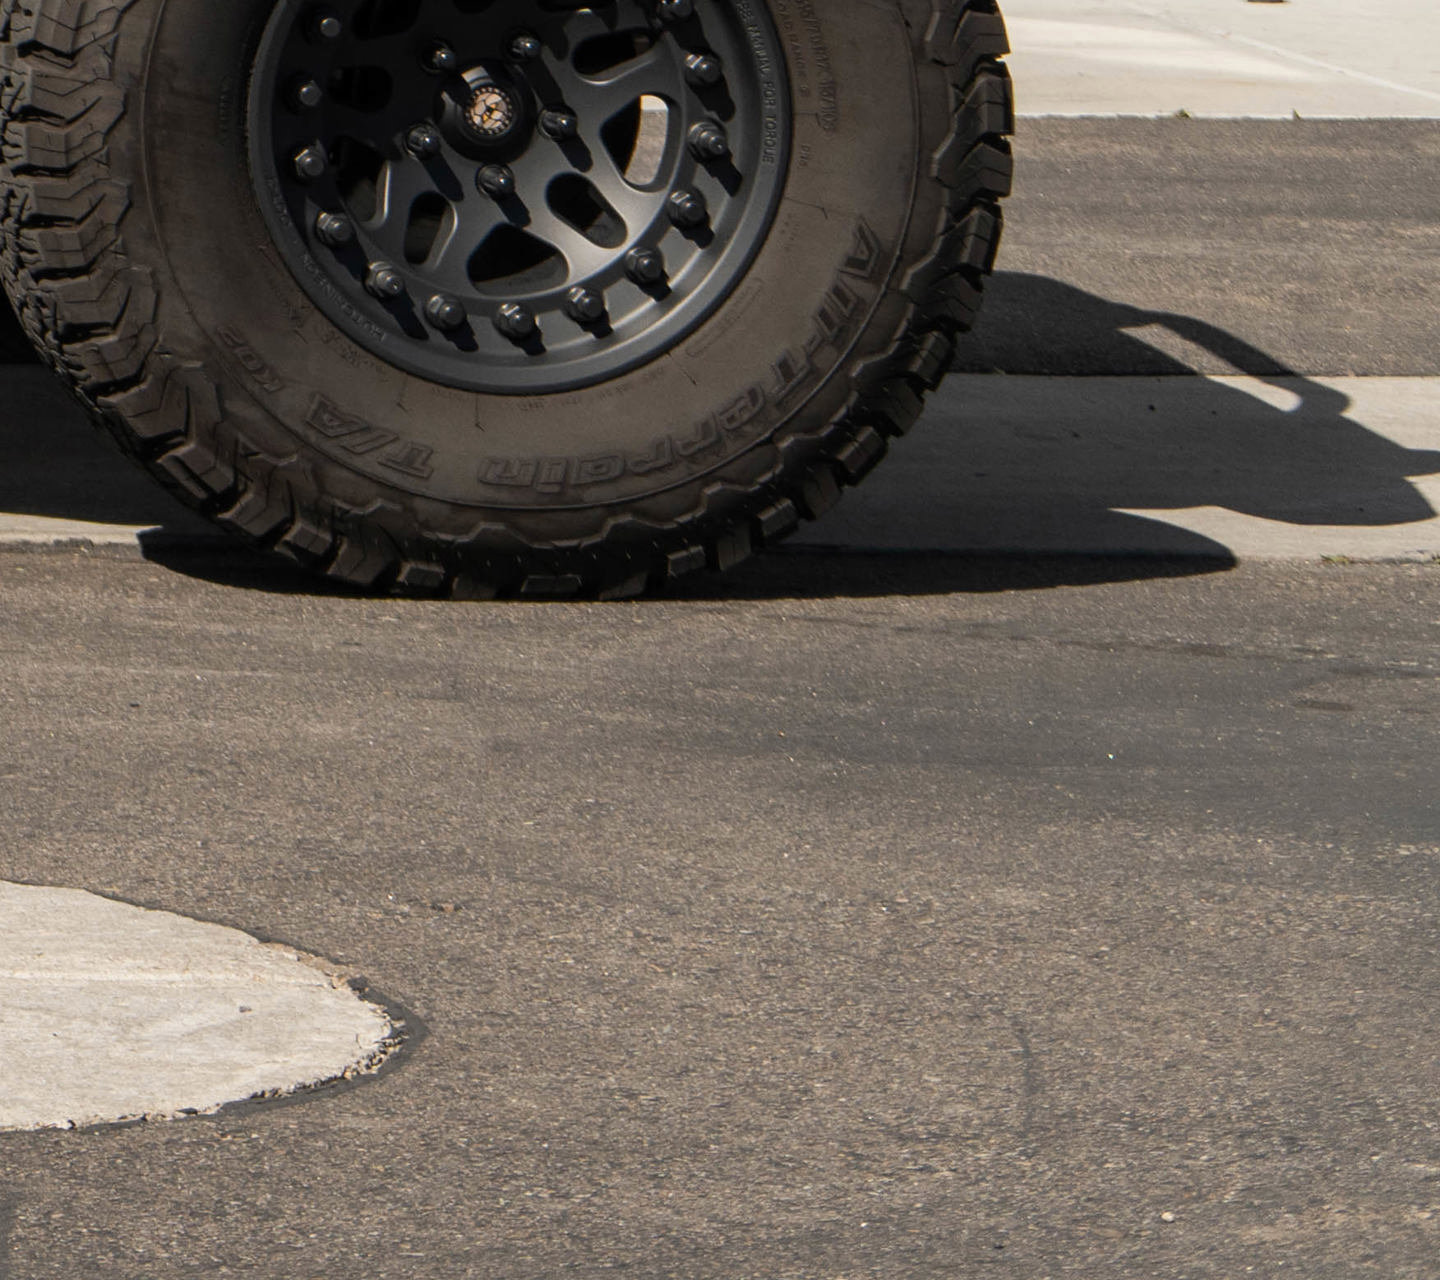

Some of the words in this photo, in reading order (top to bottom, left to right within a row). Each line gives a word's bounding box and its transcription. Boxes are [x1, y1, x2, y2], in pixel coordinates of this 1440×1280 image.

[763, 114, 776, 163] TORQUE
[478, 213, 880, 493] All-Terrain
[305, 392, 434, 479] T/A
